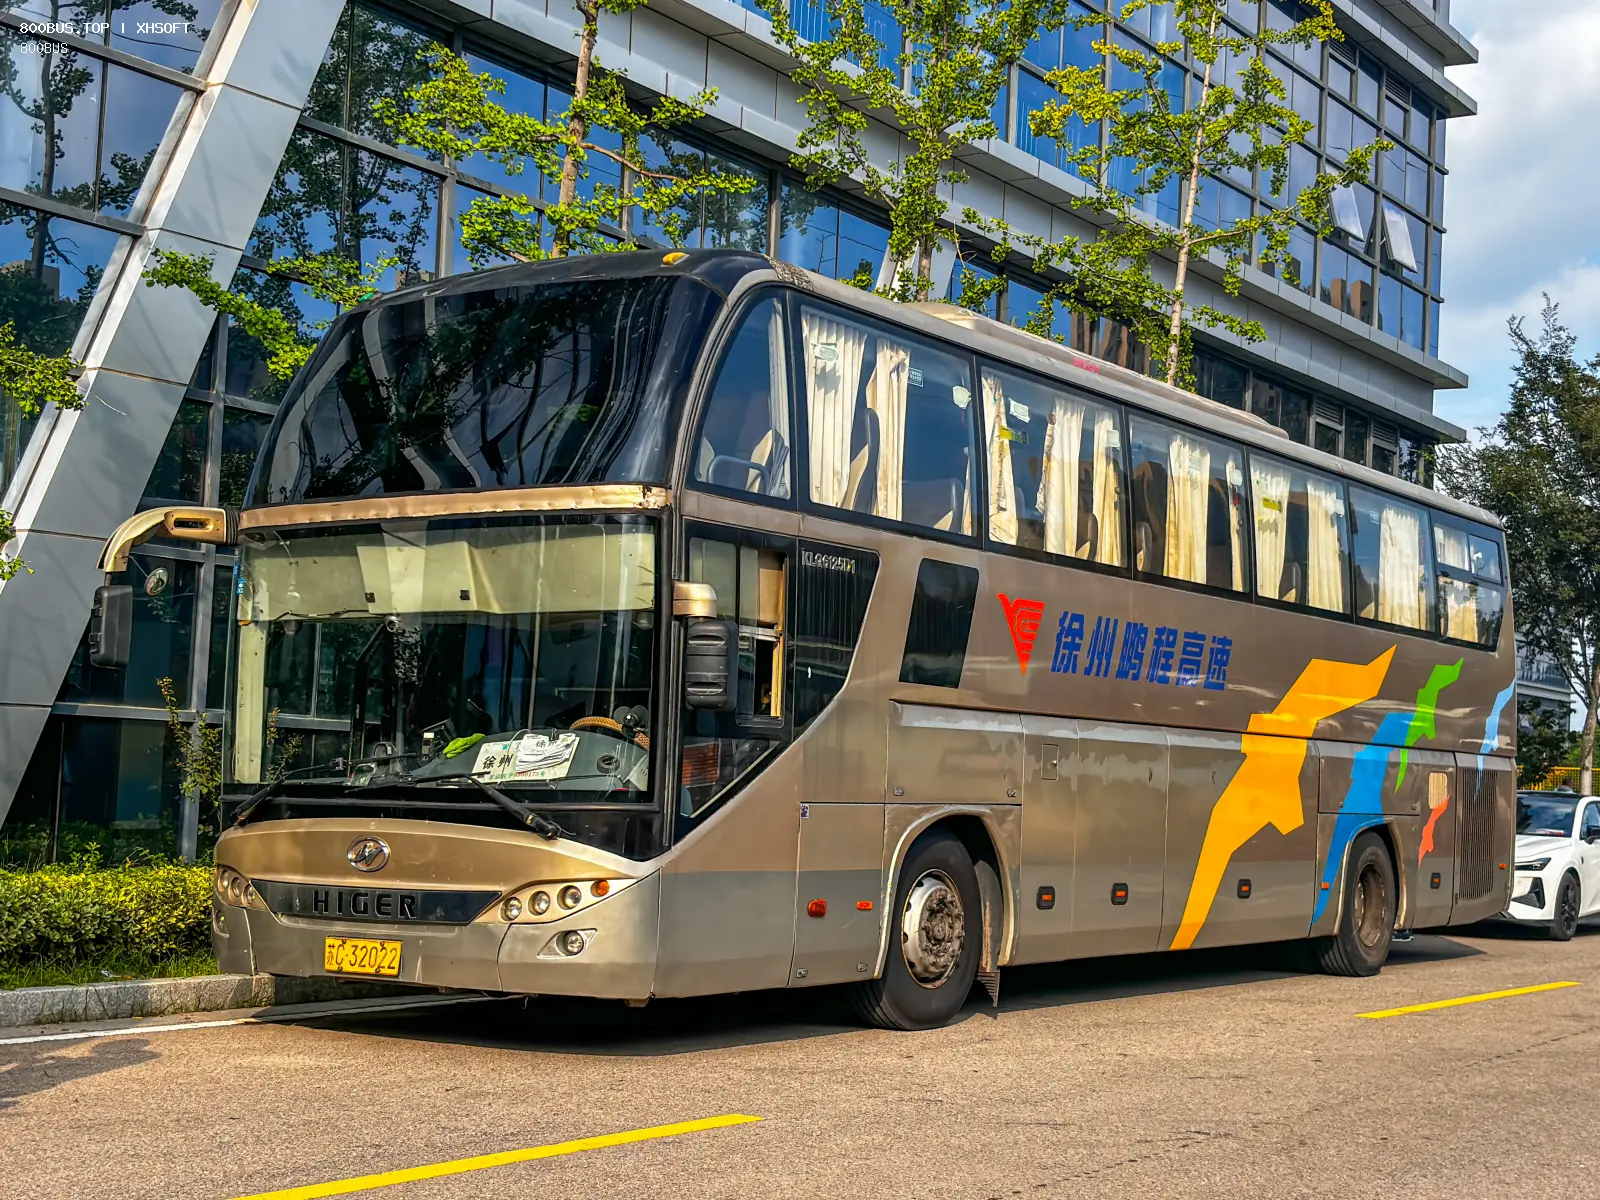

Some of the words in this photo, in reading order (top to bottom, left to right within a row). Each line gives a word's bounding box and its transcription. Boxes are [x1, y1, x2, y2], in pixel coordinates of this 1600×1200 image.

[1050, 610, 1233, 691] 徐州鹏程高速
[482, 753, 514, 770] 徐州
[312, 889, 417, 920] HIGER
